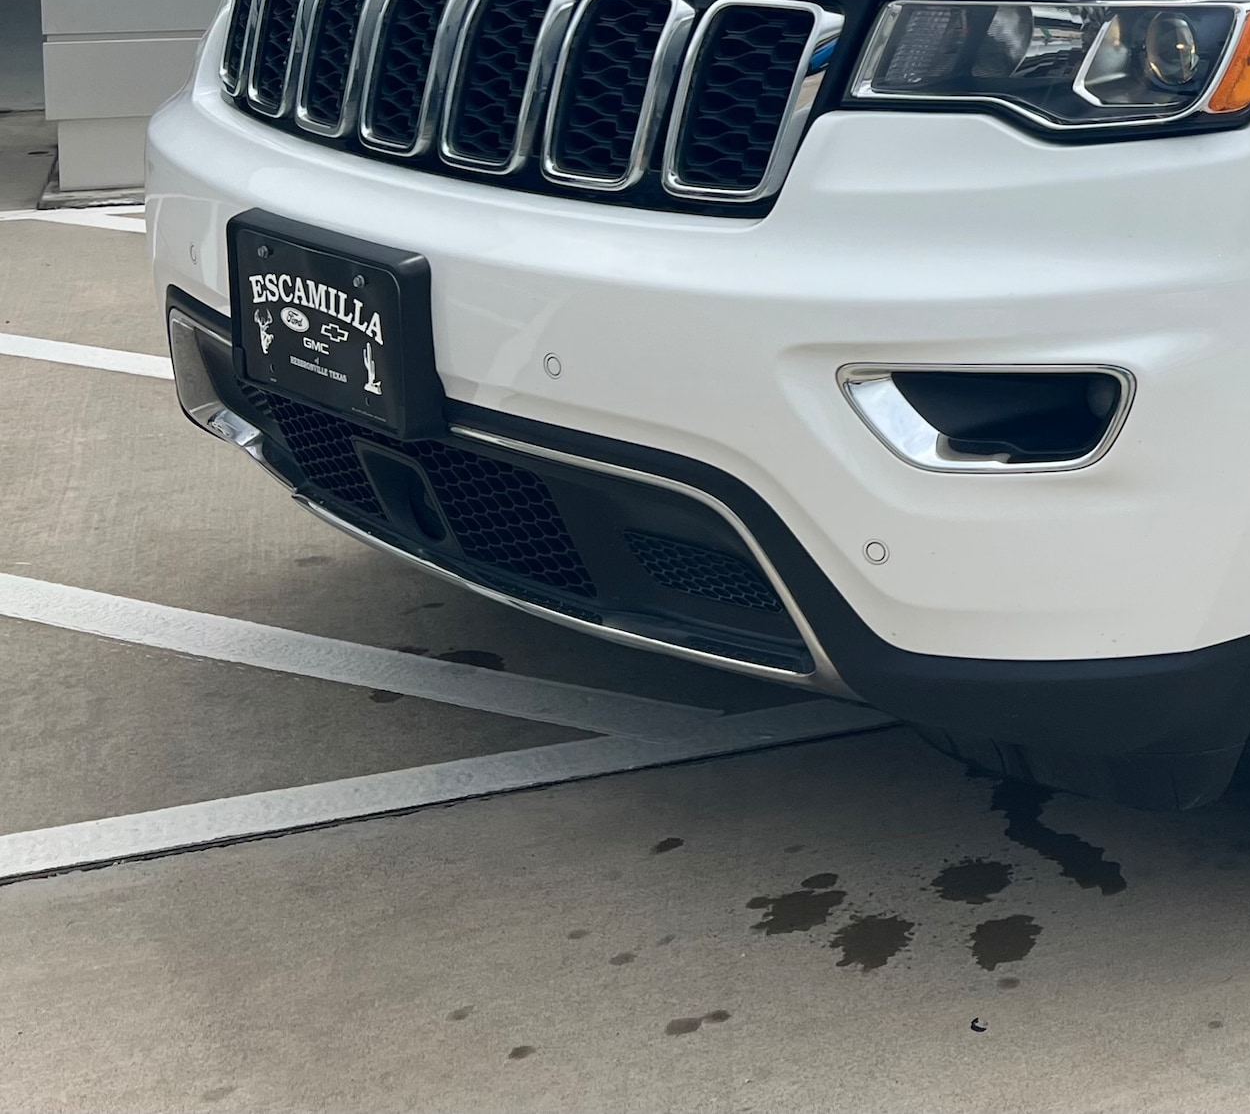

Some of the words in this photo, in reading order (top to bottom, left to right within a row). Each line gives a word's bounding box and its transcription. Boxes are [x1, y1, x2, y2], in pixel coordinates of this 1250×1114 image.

[248, 273, 384, 346] ESCAMILLA
[303, 336, 330, 355] GMC
[328, 369, 348, 383] TEXAS
